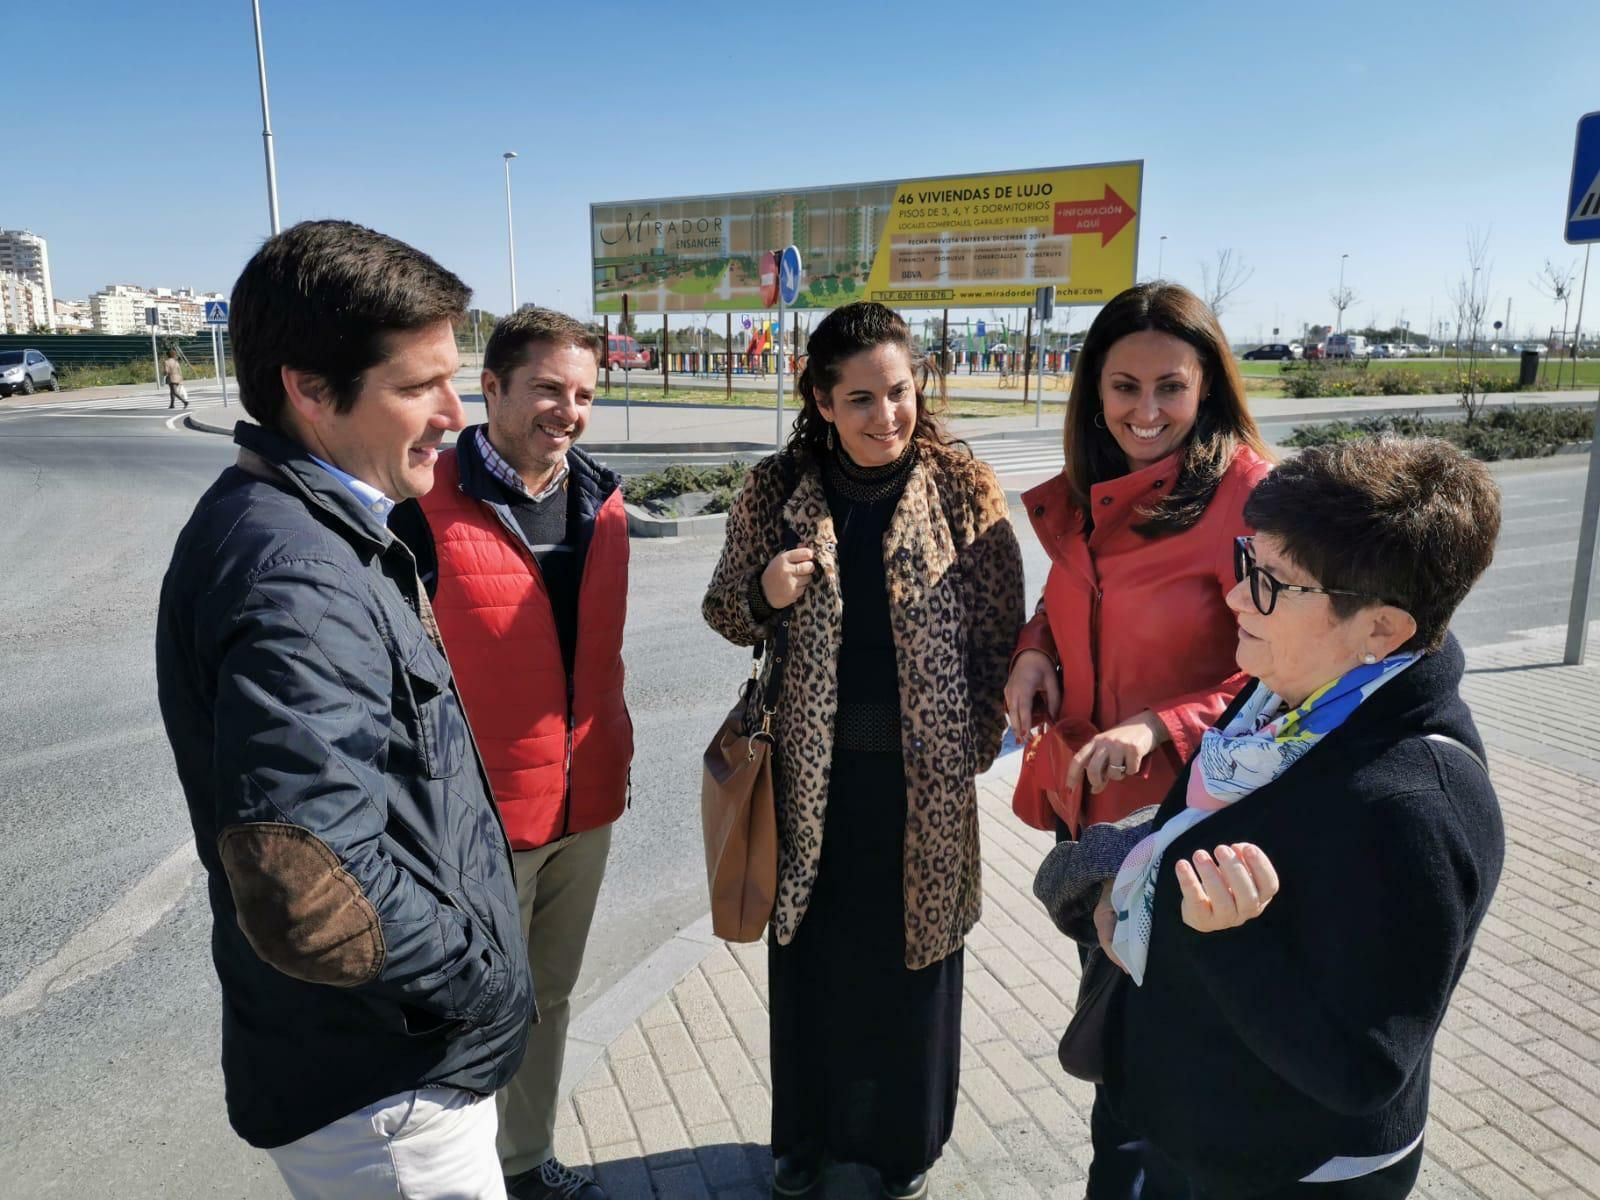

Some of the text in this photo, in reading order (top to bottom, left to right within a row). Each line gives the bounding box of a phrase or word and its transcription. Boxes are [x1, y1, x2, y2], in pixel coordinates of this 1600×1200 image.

[898, 183, 1053, 205] 46 VIVIENDAS DE LUJO
[899, 200, 1050, 218] PISOS DE 3, 4, Y 5 DORMITORIOS
[898, 221, 925, 230] LOCALES
[973, 217, 1004, 227] GARAJES
[1011, 215, 1050, 224] TRASTEROS
[676, 237, 721, 249] ENSANCHE
[961, 236, 991, 244] ENTREGA
[993, 234, 1027, 242] DICIEMBRE
